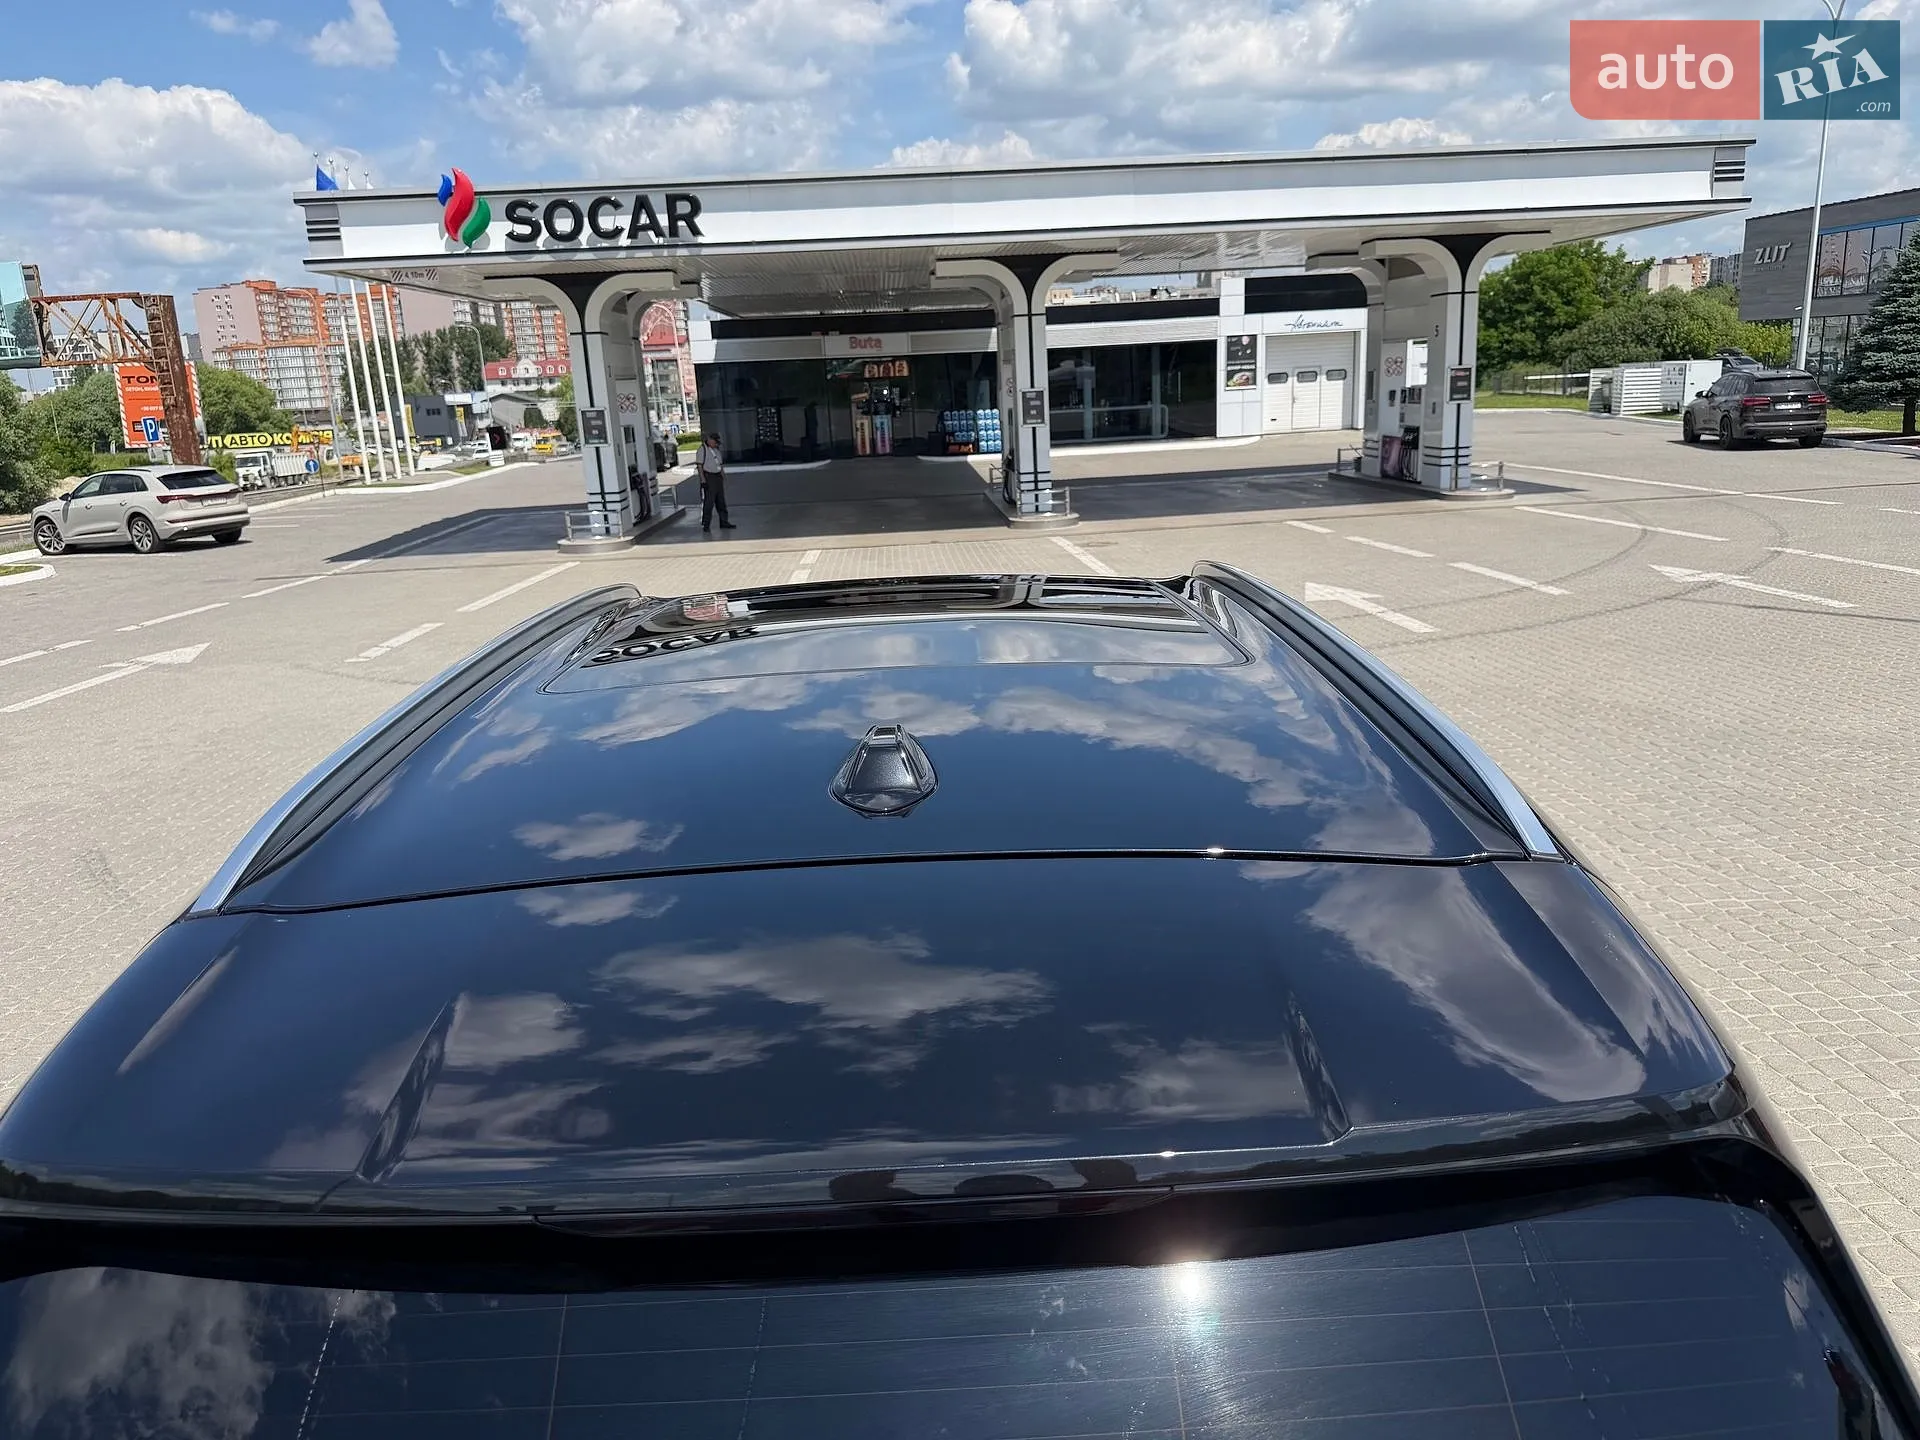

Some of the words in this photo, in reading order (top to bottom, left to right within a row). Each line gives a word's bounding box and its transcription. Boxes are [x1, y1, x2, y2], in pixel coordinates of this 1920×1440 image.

[504, 192, 705, 243] SOCAR
[1753, 241, 1792, 265] ZLIT
[848, 335, 883, 349] Buta
[146, 419, 156, 440] P
[229, 434, 268, 446] АВТО
